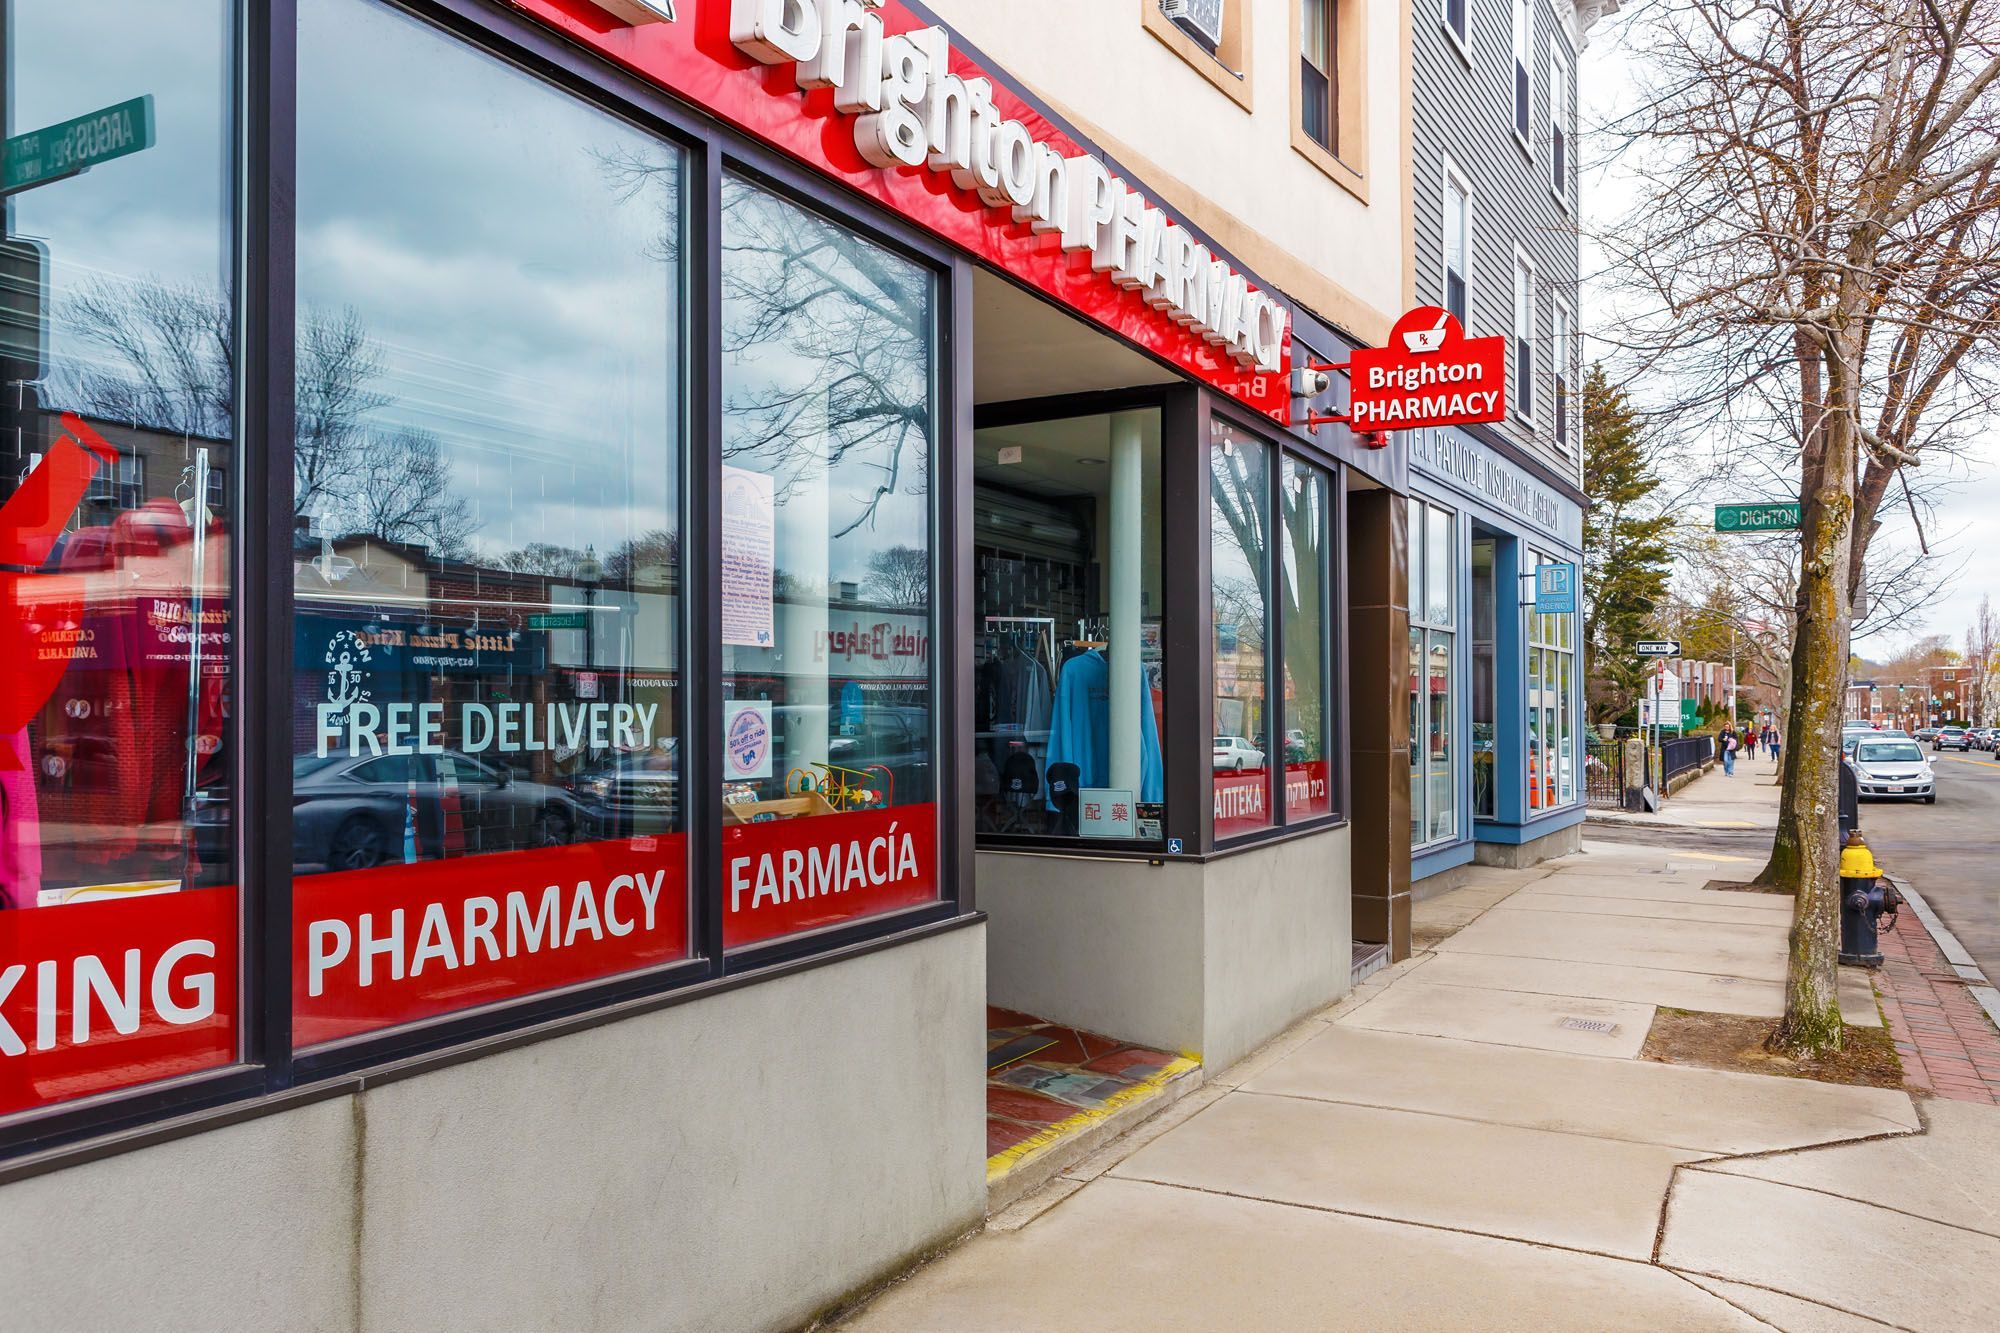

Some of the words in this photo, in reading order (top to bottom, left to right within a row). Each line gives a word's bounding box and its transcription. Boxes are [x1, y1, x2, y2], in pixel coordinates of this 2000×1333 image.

[1064, 153, 1288, 374] PHARMACY
[1369, 361, 1483, 391] Brighton
[1353, 391, 1499, 423] PHARMACY
[1434, 429, 1482, 491] PATNODE
[1485, 459, 1532, 518] INSURANCE
[1532, 489, 1560, 531] AGENCY
[1740, 509, 1798, 526] DIGHTON
[1540, 602, 1569, 610] AGENCY
[325, 629, 372, 664] BOSTON
[328, 675, 336, 684] 16
[350, 674, 361, 683] 30
[317, 703, 443, 758] FREE
[462, 703, 658, 753] DELIVERY
[754, 729, 765, 737] ride
[1085, 803, 1127, 821] 配藥
[1214, 784, 1262, 819] АПТЕКА
[731, 821, 919, 912] FARMACÍA
[308, 869, 666, 998] PHARMACY
